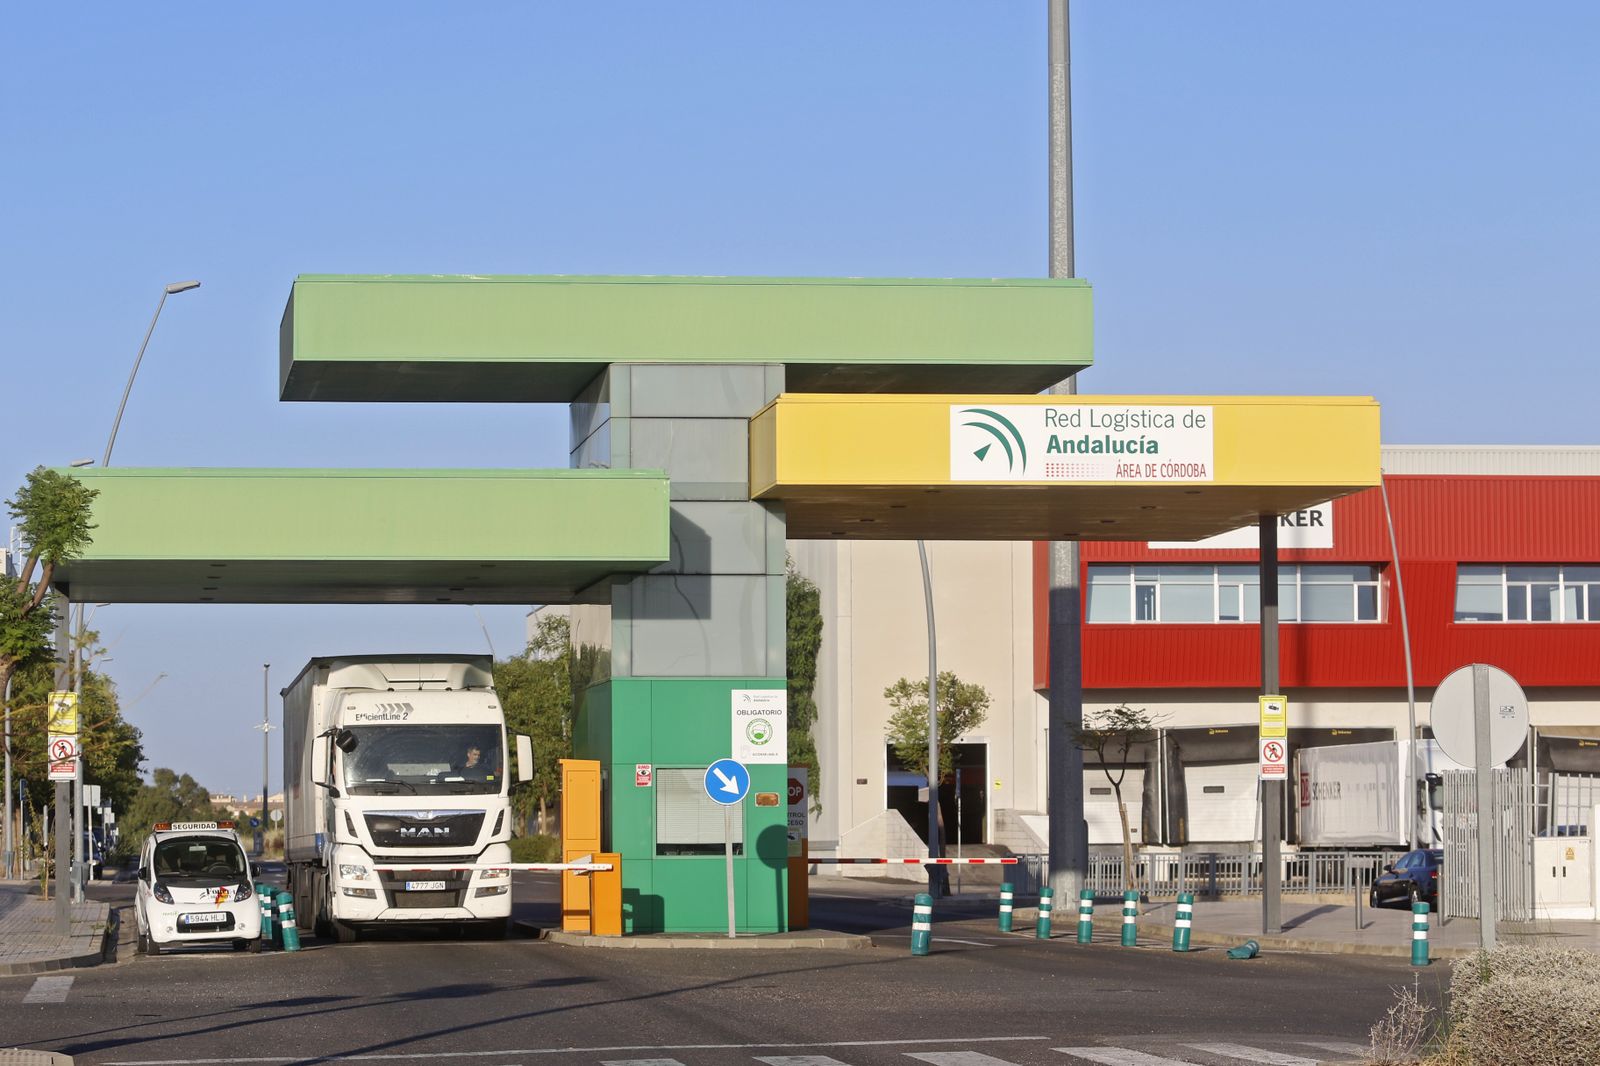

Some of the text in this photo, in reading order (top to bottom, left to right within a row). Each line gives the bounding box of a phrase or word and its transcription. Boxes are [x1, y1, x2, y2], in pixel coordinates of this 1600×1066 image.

[1045, 408, 1206, 432] Red Logística de
[1046, 434, 1159, 454] Andalucía
[1116, 459, 1207, 478] ÁREA DE CÓRDOBA
[1280, 509, 1324, 527] KER
[402, 712, 409, 721] 2
[788, 786, 802, 797] OP
[1312, 781, 1342, 801] SCHENKER
[400, 827, 450, 838] MAN
[190, 914, 209, 923] 5944
